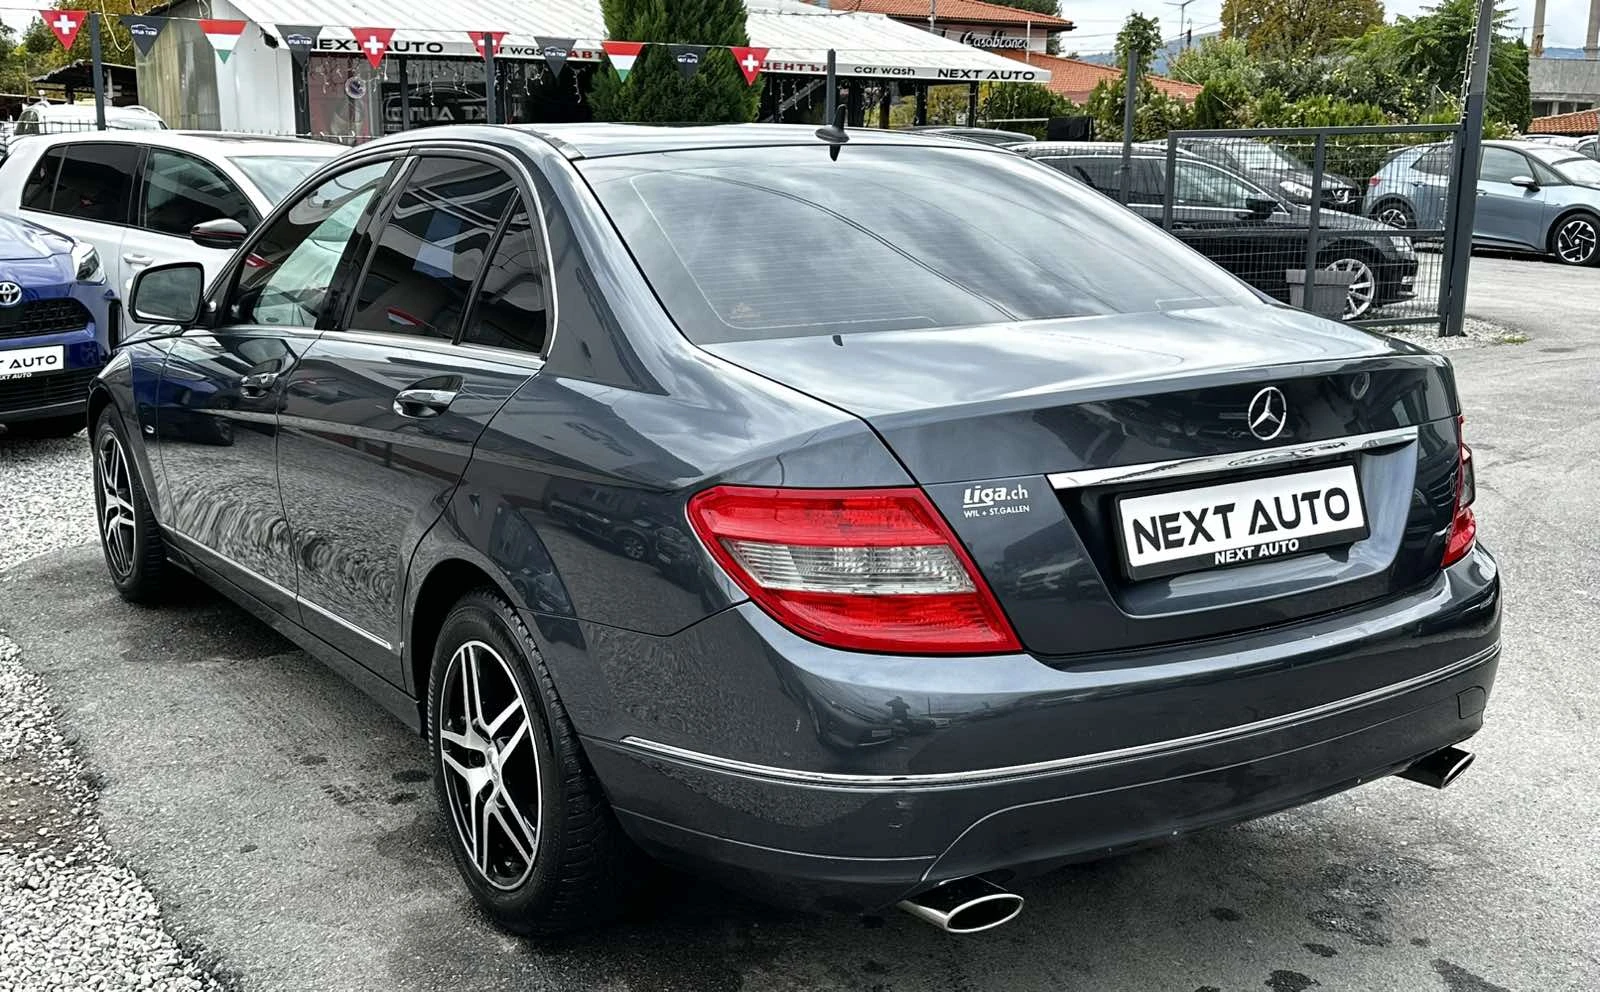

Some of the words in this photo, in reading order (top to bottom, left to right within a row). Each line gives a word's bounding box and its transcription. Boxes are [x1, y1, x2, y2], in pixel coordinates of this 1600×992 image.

[312, 38, 362, 51] EXT
[963, 30, 1031, 49] Casablanca
[854, 65, 877, 74] car
[881, 66, 916, 76] wash
[937, 68, 983, 79] NEXT
[986, 71, 1035, 81] AUTO
[9, 354, 57, 369] AUTO
[963, 484, 1029, 508] Liga.ch
[963, 510, 980, 518] WIL
[989, 505, 1030, 516] ST.GALLEN
[1132, 502, 1236, 555] NEXT
[1248, 487, 1350, 536] AUTO
[1214, 546, 1255, 565] NEXT
[1258, 538, 1299, 557] AUTO
